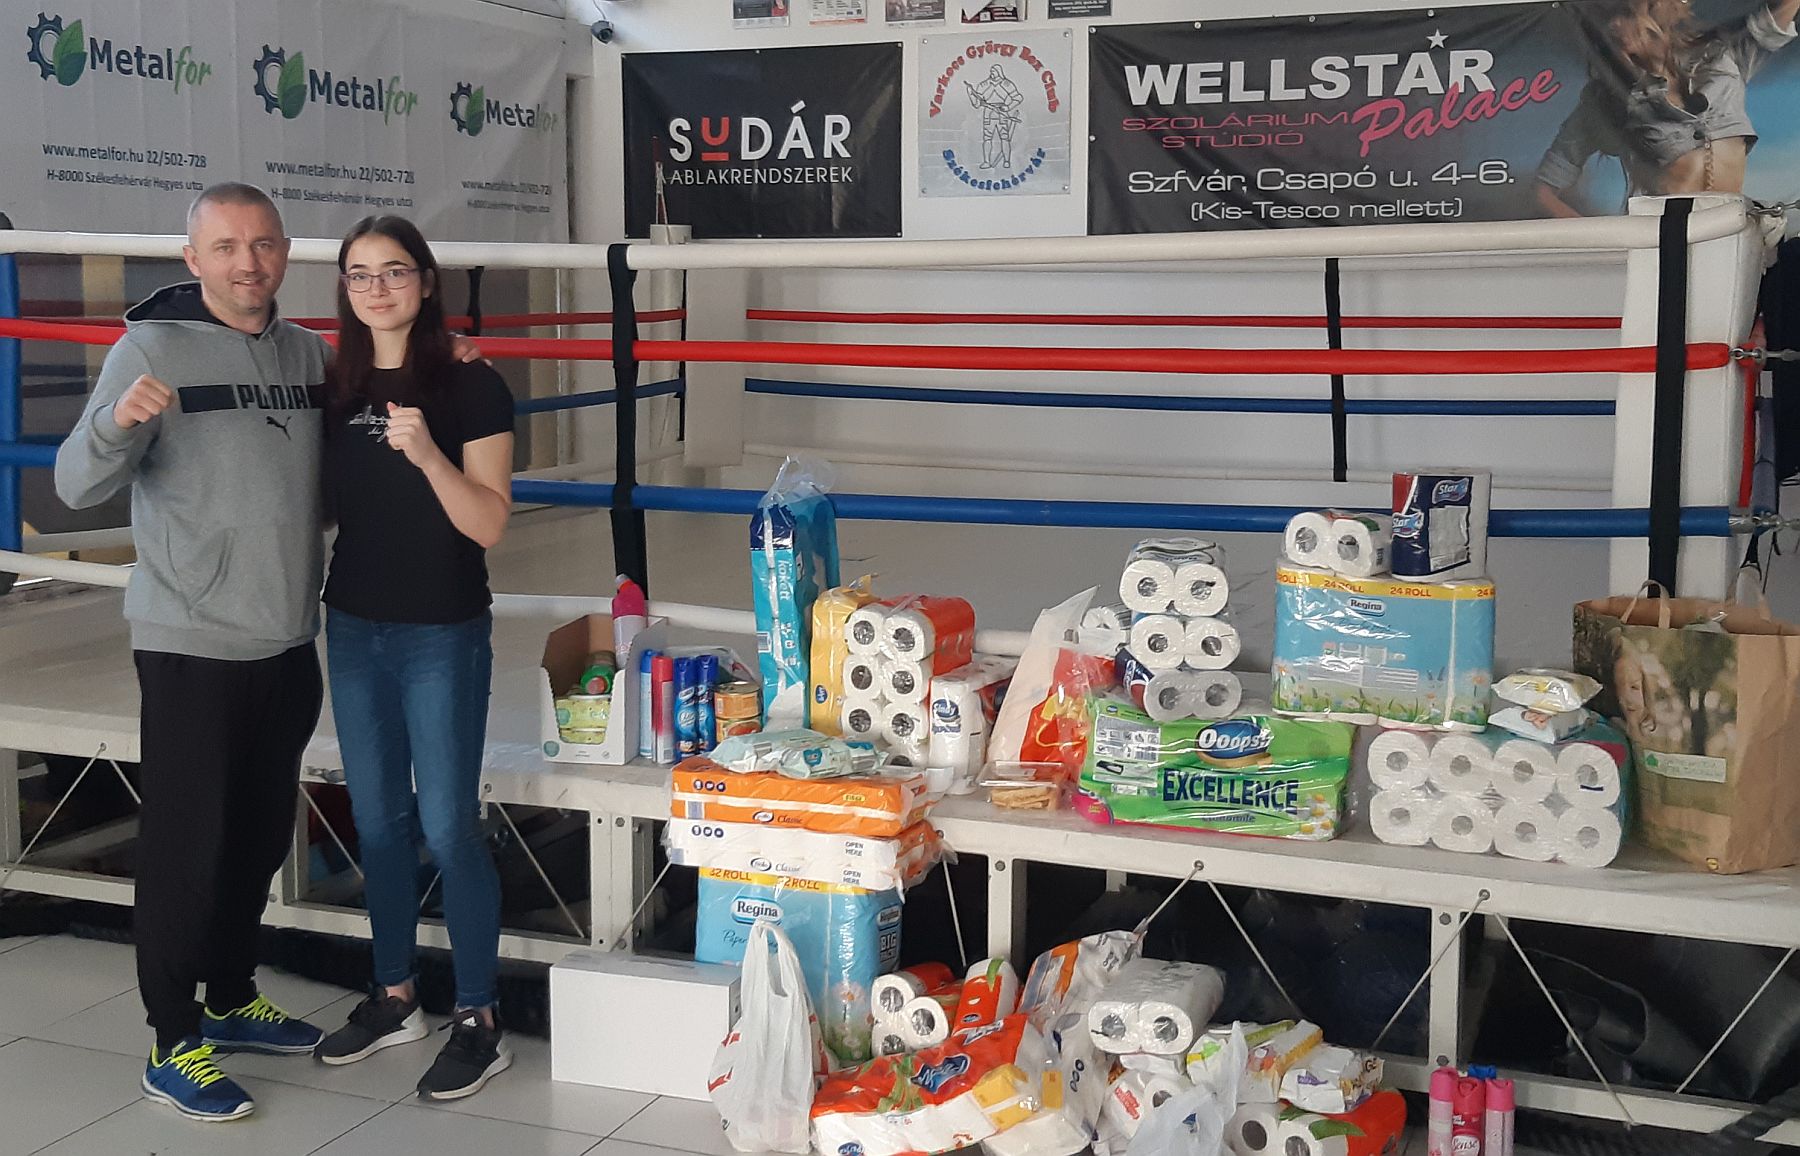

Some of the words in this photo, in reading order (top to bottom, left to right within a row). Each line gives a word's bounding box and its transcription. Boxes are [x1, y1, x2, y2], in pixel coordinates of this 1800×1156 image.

[90, 37, 212, 95] Metalfor
[1124, 48, 1496, 106] WELLSTAR
[309, 69, 418, 126] Metalfor
[1041, 70, 1060, 113] Club
[1122, 112, 1349, 131] SZOLÁRIUM
[1351, 68, 1562, 158] Palace
[669, 100, 852, 162] SUDÁR
[1162, 130, 1304, 148] STÚDIÓ
[42, 143, 144, 163] www.metalfor.hu
[146, 150, 207, 168] 22/502-728
[47, 169, 84, 183] H-8000
[670, 166, 853, 186] ABLAKRENDSZEREK
[1256, 164, 1377, 194] Csapó
[1389, 170, 1418, 187] u.
[1431, 160, 1515, 185] 4-6.
[1190, 201, 1340, 222] (Kis-Tesco
[1349, 197, 1463, 219] mellett)
[776, 559, 793, 601] kokett
[1390, 586, 1404, 595] 24
[1405, 587, 1432, 597] ROLL
[1350, 598, 1383, 612] Regina
[1162, 767, 1300, 816] EXCELLENCE
[723, 870, 752, 881] ROLL
[792, 877, 820, 890] ROLL
[736, 899, 779, 918] Regina
[880, 933, 897, 951] BIG
